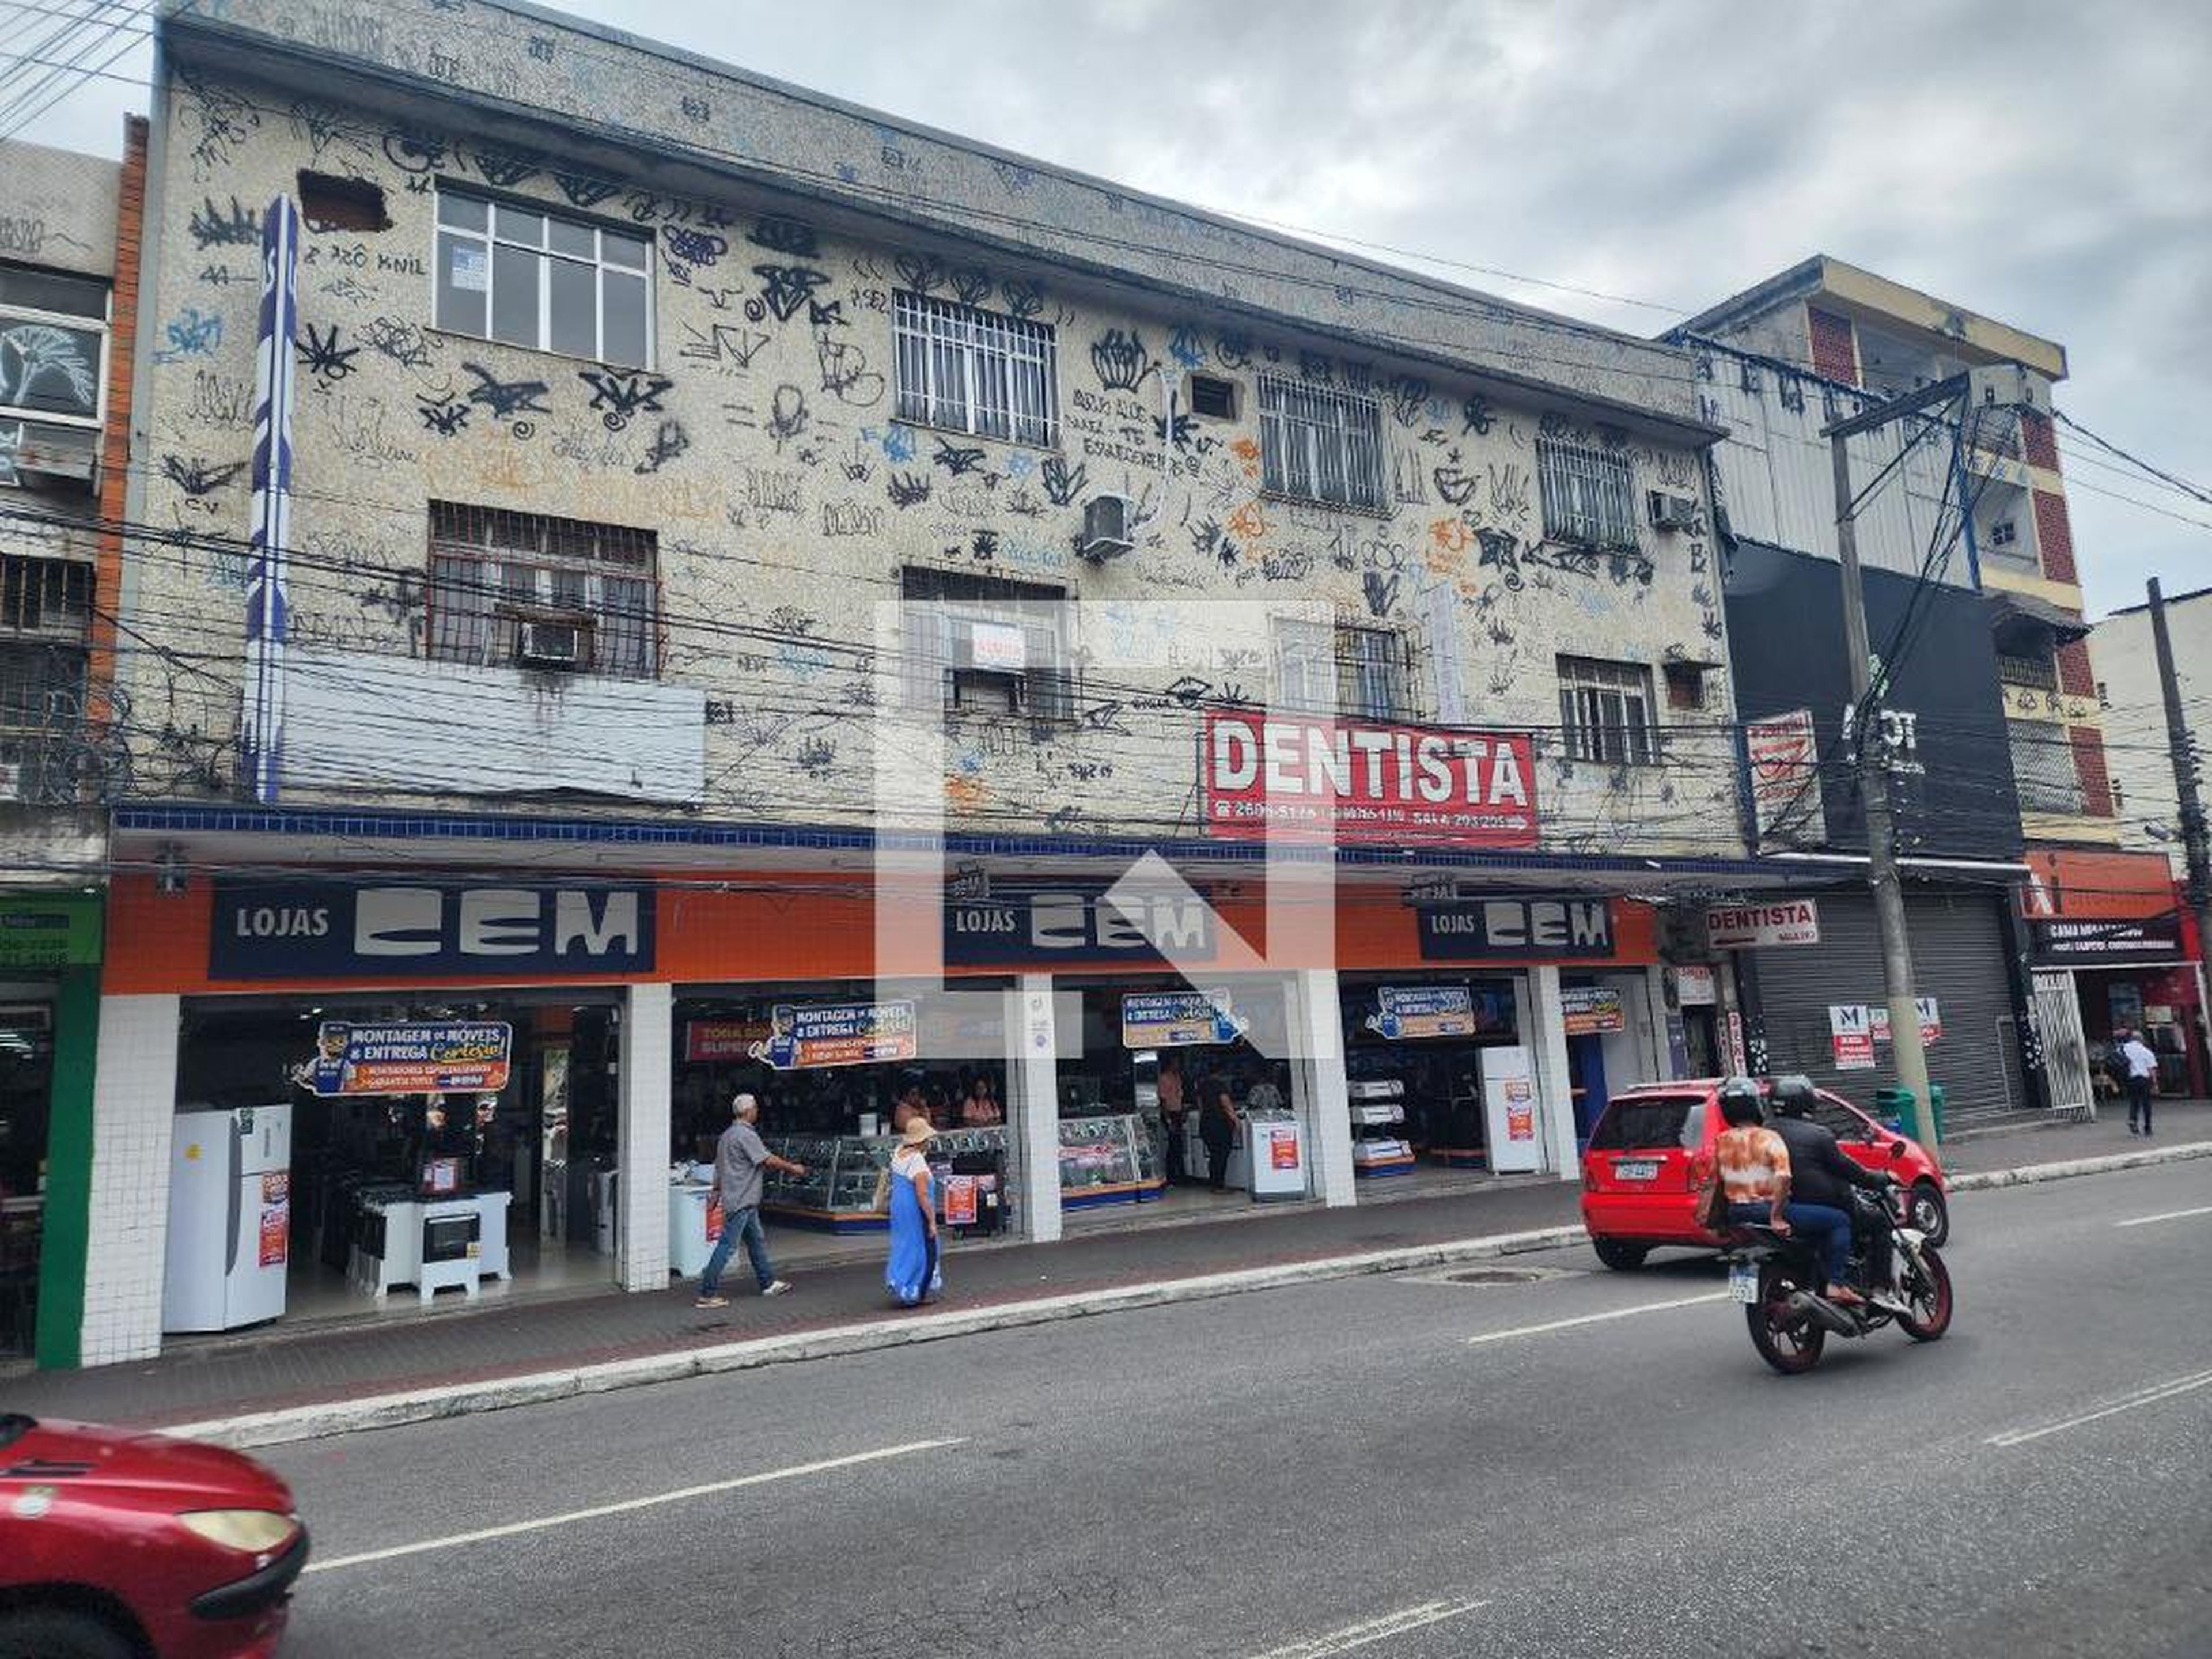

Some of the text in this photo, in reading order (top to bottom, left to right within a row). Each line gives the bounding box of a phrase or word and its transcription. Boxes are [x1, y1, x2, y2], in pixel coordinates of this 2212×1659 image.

[1213, 720, 1529, 806] DENTISTA
[236, 888, 638, 955] LOJAS CEM
[955, 894, 1206, 948] LOJAS CEM
[1431, 901, 1608, 946] LOJAS CEM
[1707, 905, 1812, 931] DENTISTA
[351, 1029, 431, 1043] MONTAGEM
[447, 1027, 500, 1042] MÓVEIS
[364, 1045, 427, 1060] ENTREGA
